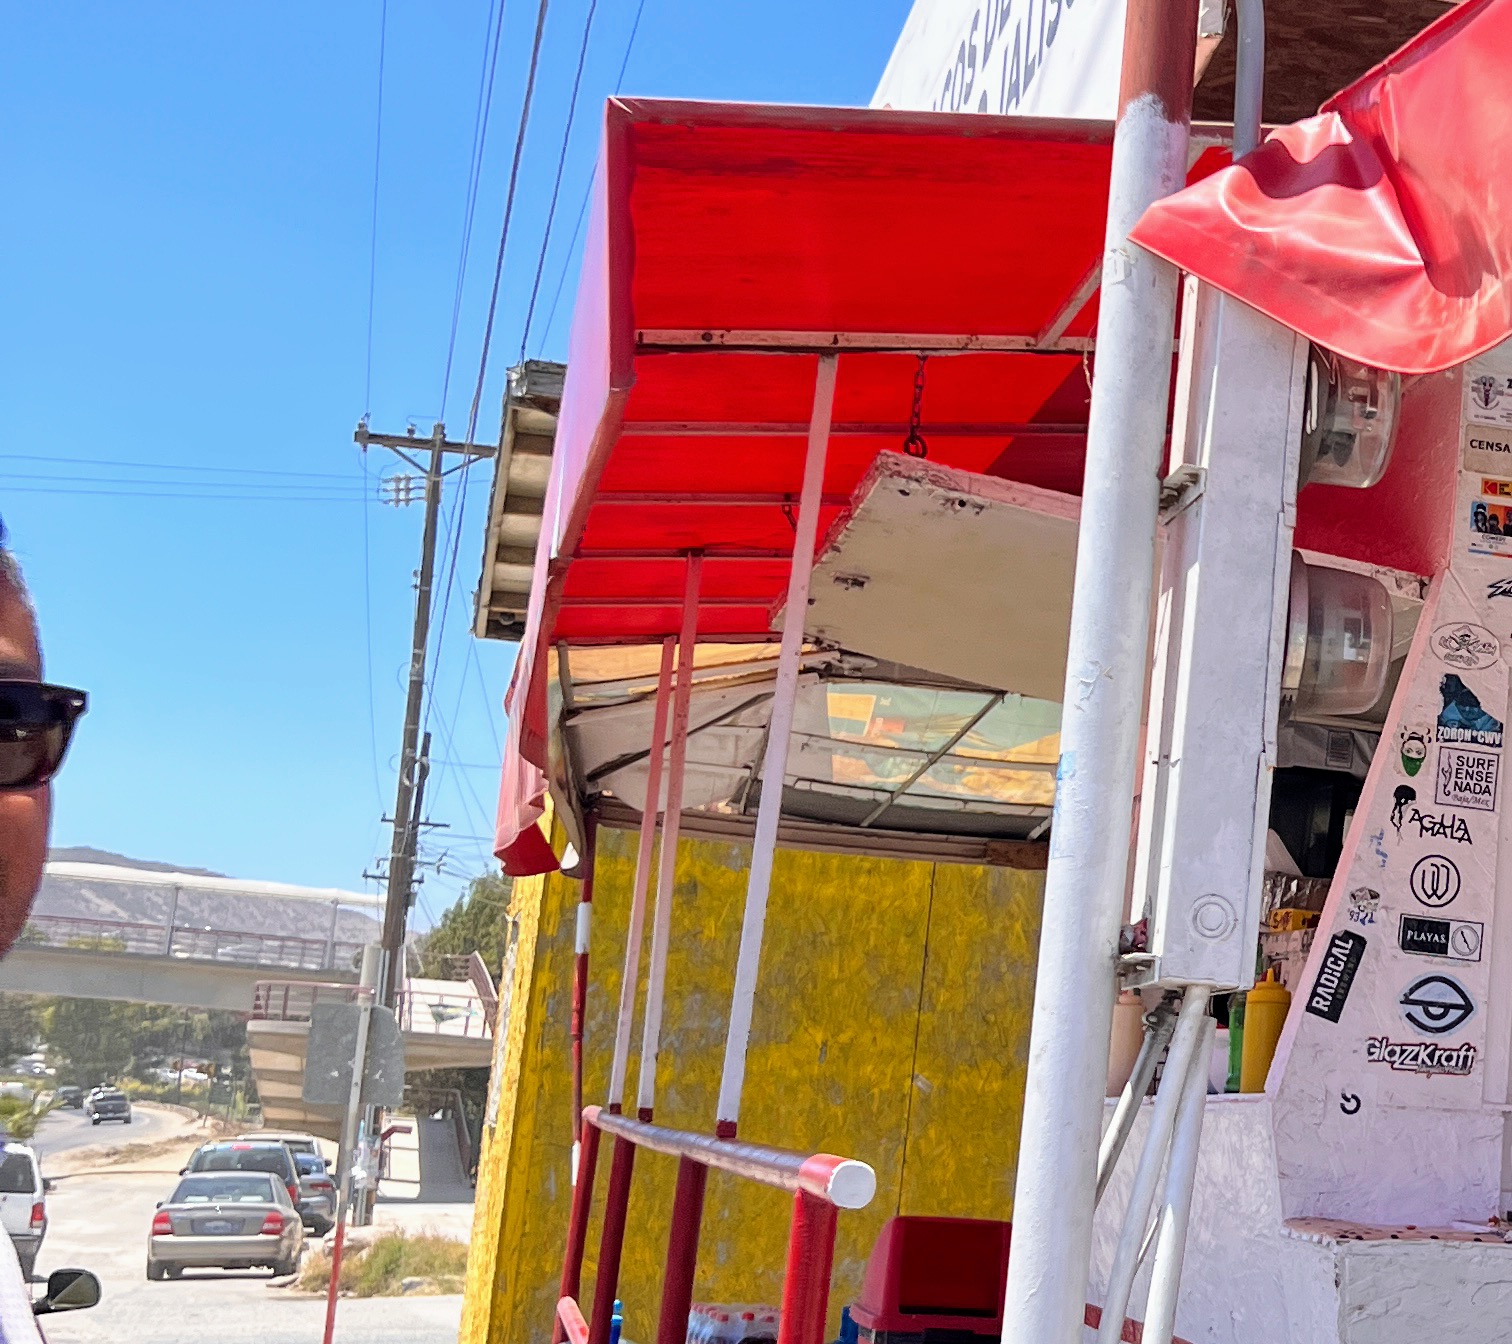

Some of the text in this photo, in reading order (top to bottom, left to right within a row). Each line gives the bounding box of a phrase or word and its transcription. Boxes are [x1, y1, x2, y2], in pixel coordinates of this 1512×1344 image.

[1455, 755, 1496, 771] SURF
[1454, 767, 1494, 784] ENSE
[1452, 781, 1492, 796] NADA
[1406, 929, 1447, 944] PLAYAS
